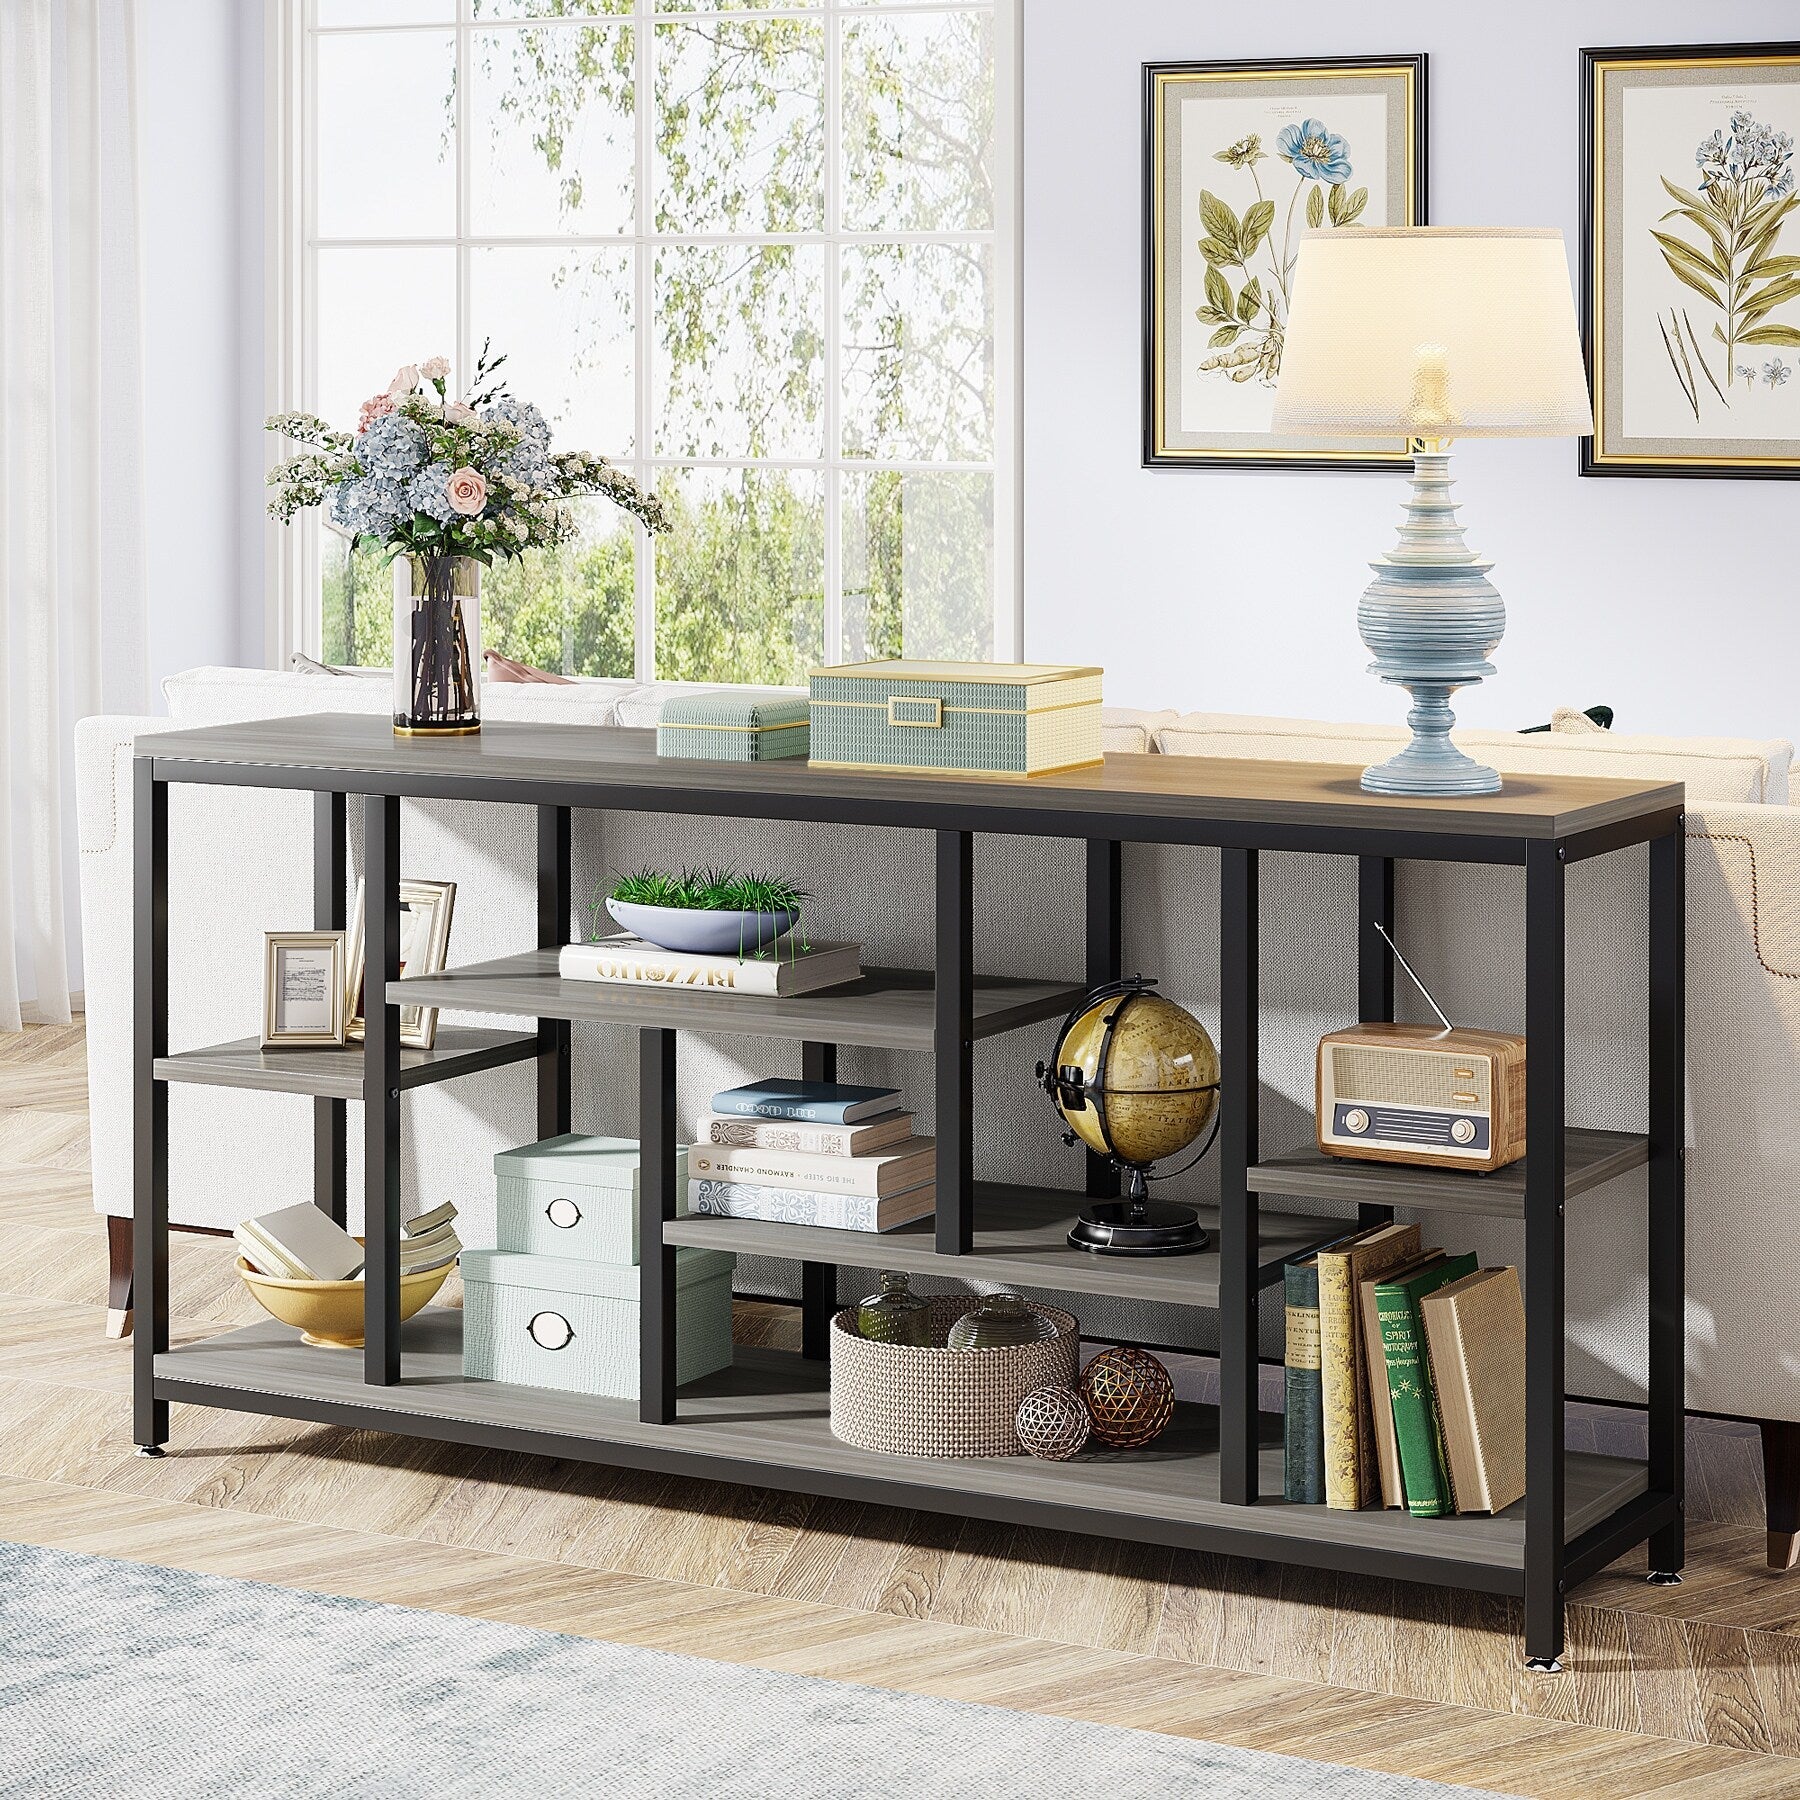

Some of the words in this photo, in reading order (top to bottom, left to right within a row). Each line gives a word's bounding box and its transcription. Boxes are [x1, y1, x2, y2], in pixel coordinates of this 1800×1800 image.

[716, 1164, 755, 1174] CHANDLER
[756, 1168, 794, 1178] RAYMOND
[803, 1173, 824, 1181] SLEEP
[826, 1175, 840, 1183] BIG
[842, 1176, 856, 1185] THE
[1385, 1330, 1412, 1341] SPIRIT
